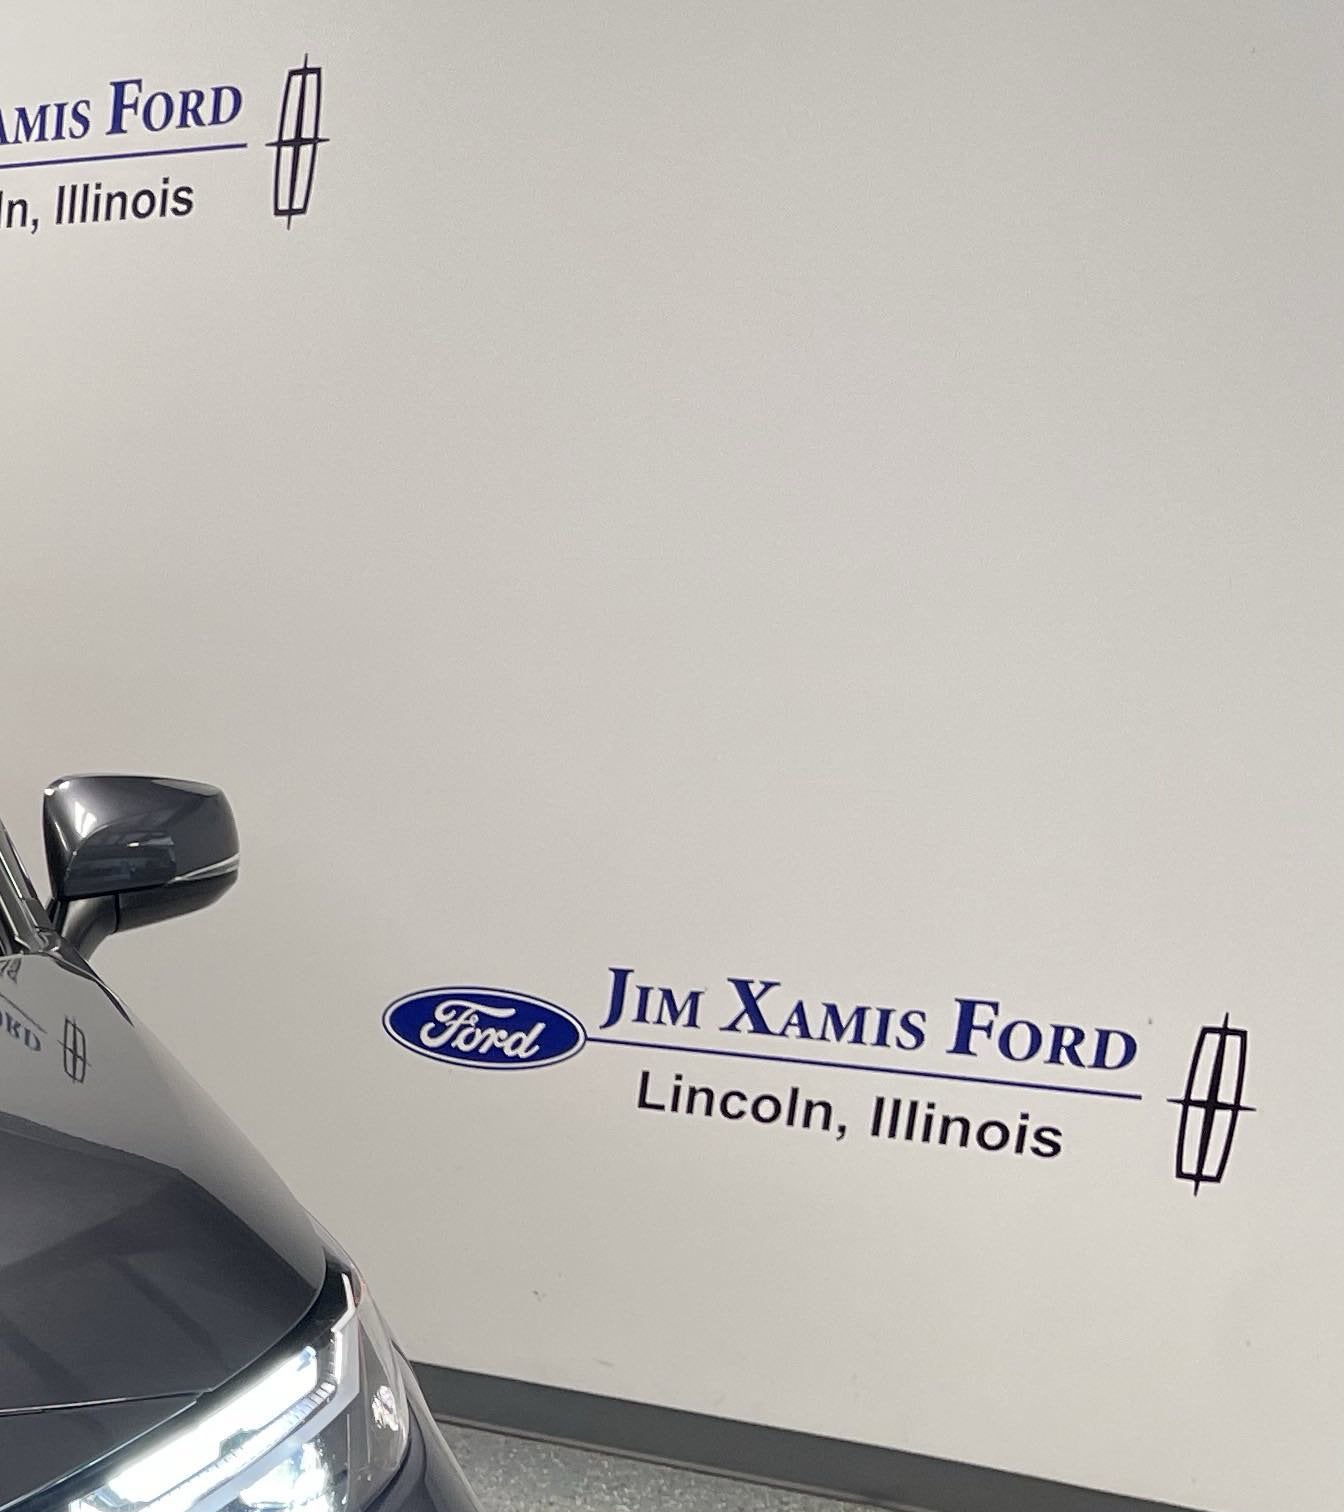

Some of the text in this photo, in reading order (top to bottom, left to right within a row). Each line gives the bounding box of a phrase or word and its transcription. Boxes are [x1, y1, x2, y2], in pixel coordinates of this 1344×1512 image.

[106, 79, 243, 136] FORD
[55, 178, 193, 225] Illinois
[420, 1000, 541, 1059] Ford
[600, 967, 1138, 1070] JIM XAMIS FORD
[637, 1071, 1063, 1158] Lincoln, Illinois
